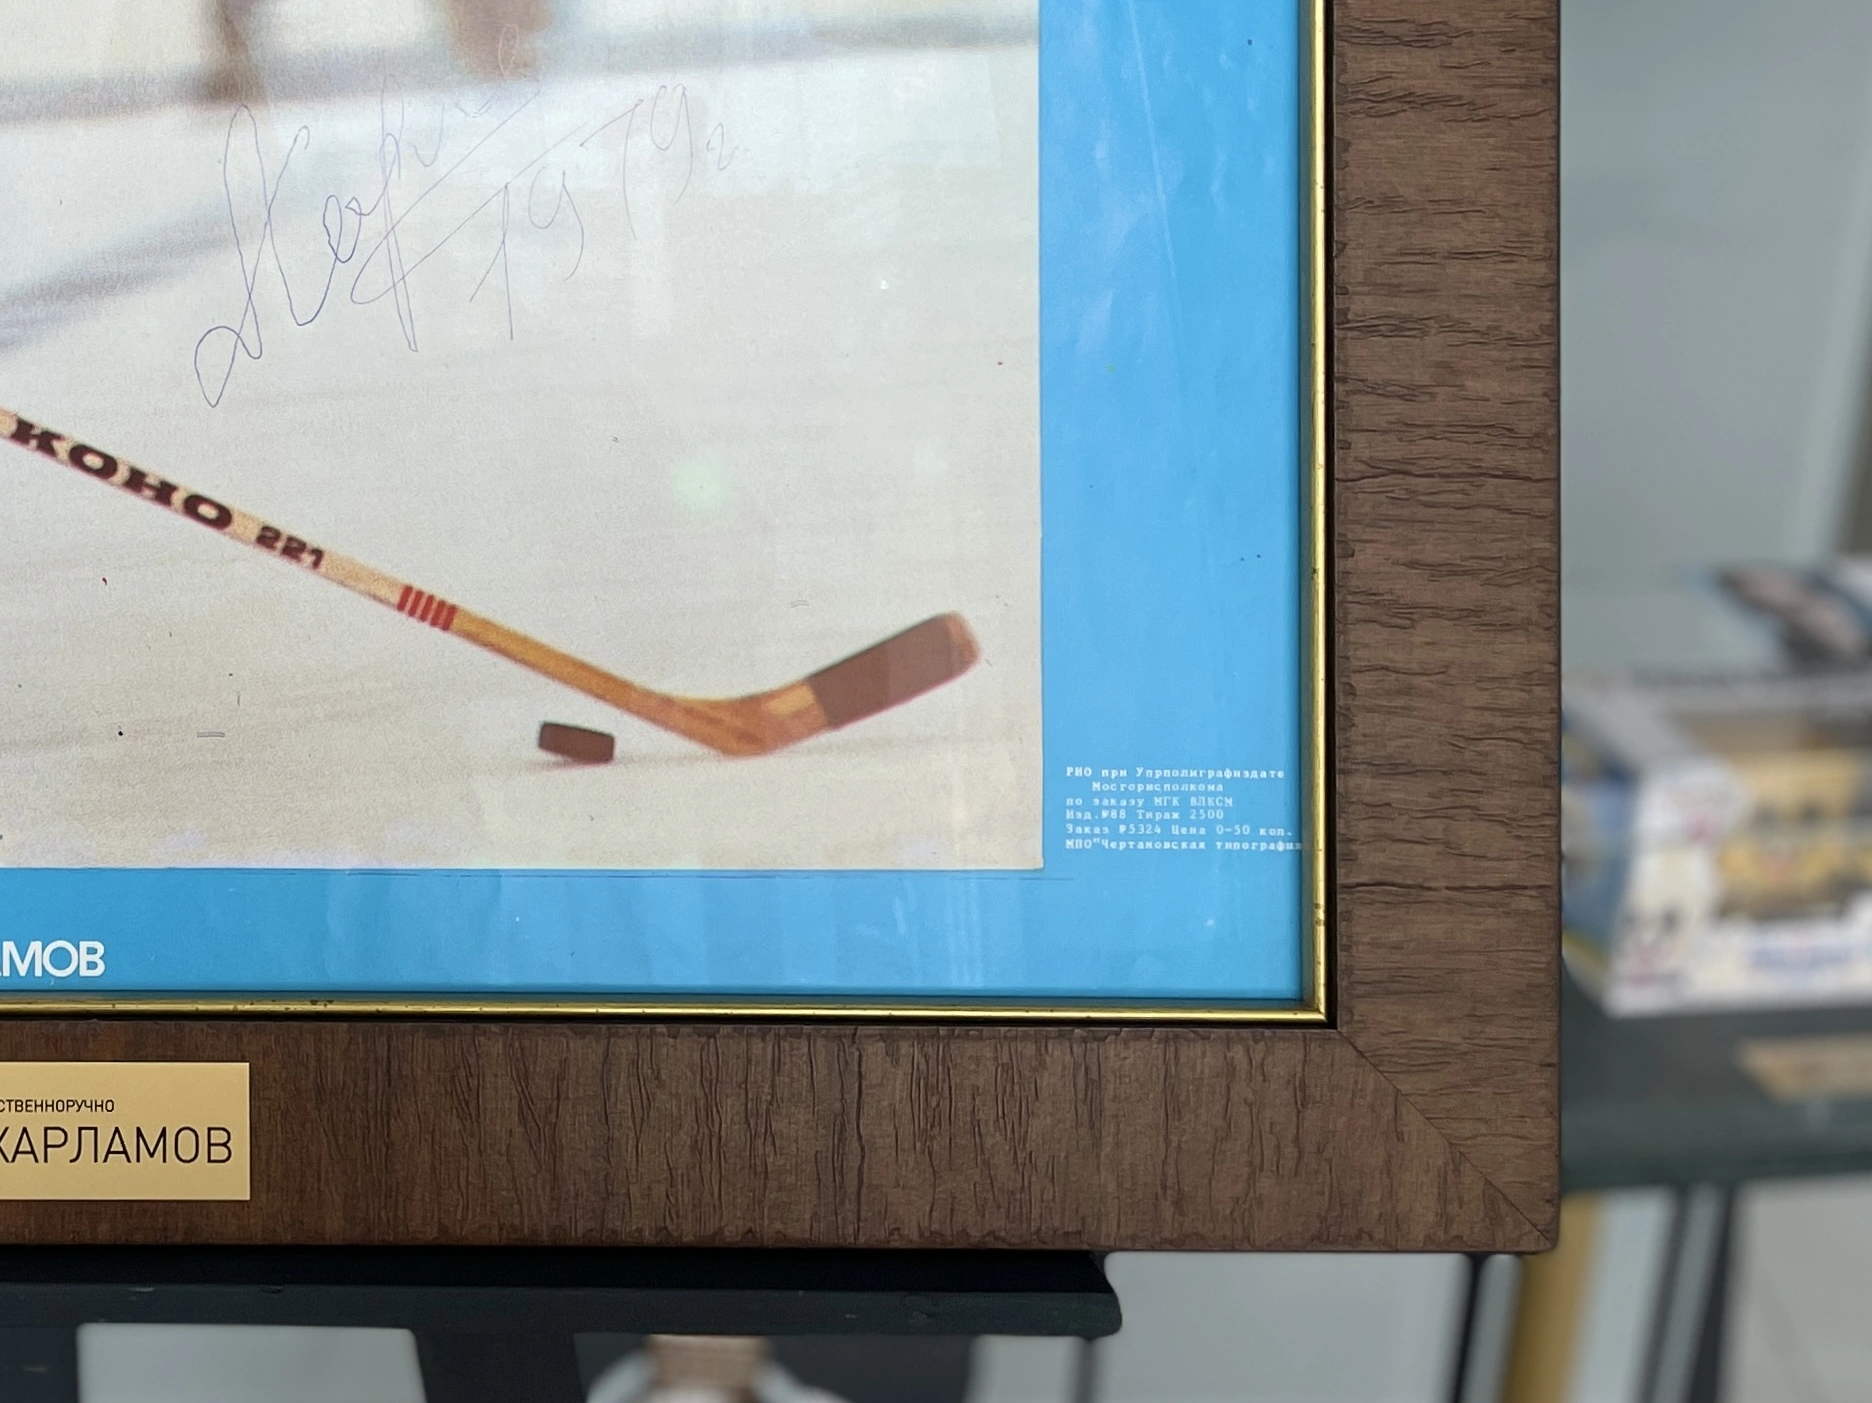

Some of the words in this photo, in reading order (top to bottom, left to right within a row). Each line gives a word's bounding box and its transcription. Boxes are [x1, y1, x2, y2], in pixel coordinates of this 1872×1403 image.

[9, 416, 233, 531] KOHO
[255, 524, 326, 570] 221
[1092, 781, 1223, 792] Мосгорисполкома
[1066, 797, 1083, 806] по
[1093, 797, 1145, 808] заказу
[1154, 796, 1179, 806] МГК
[1190, 796, 1233, 807] ВЛКСМ
[1136, 810, 1180, 821] Тираж
[1190, 809, 1224, 820] 2500
[1065, 823, 1109, 834] Заказ
[1171, 824, 1206, 836] Цена
